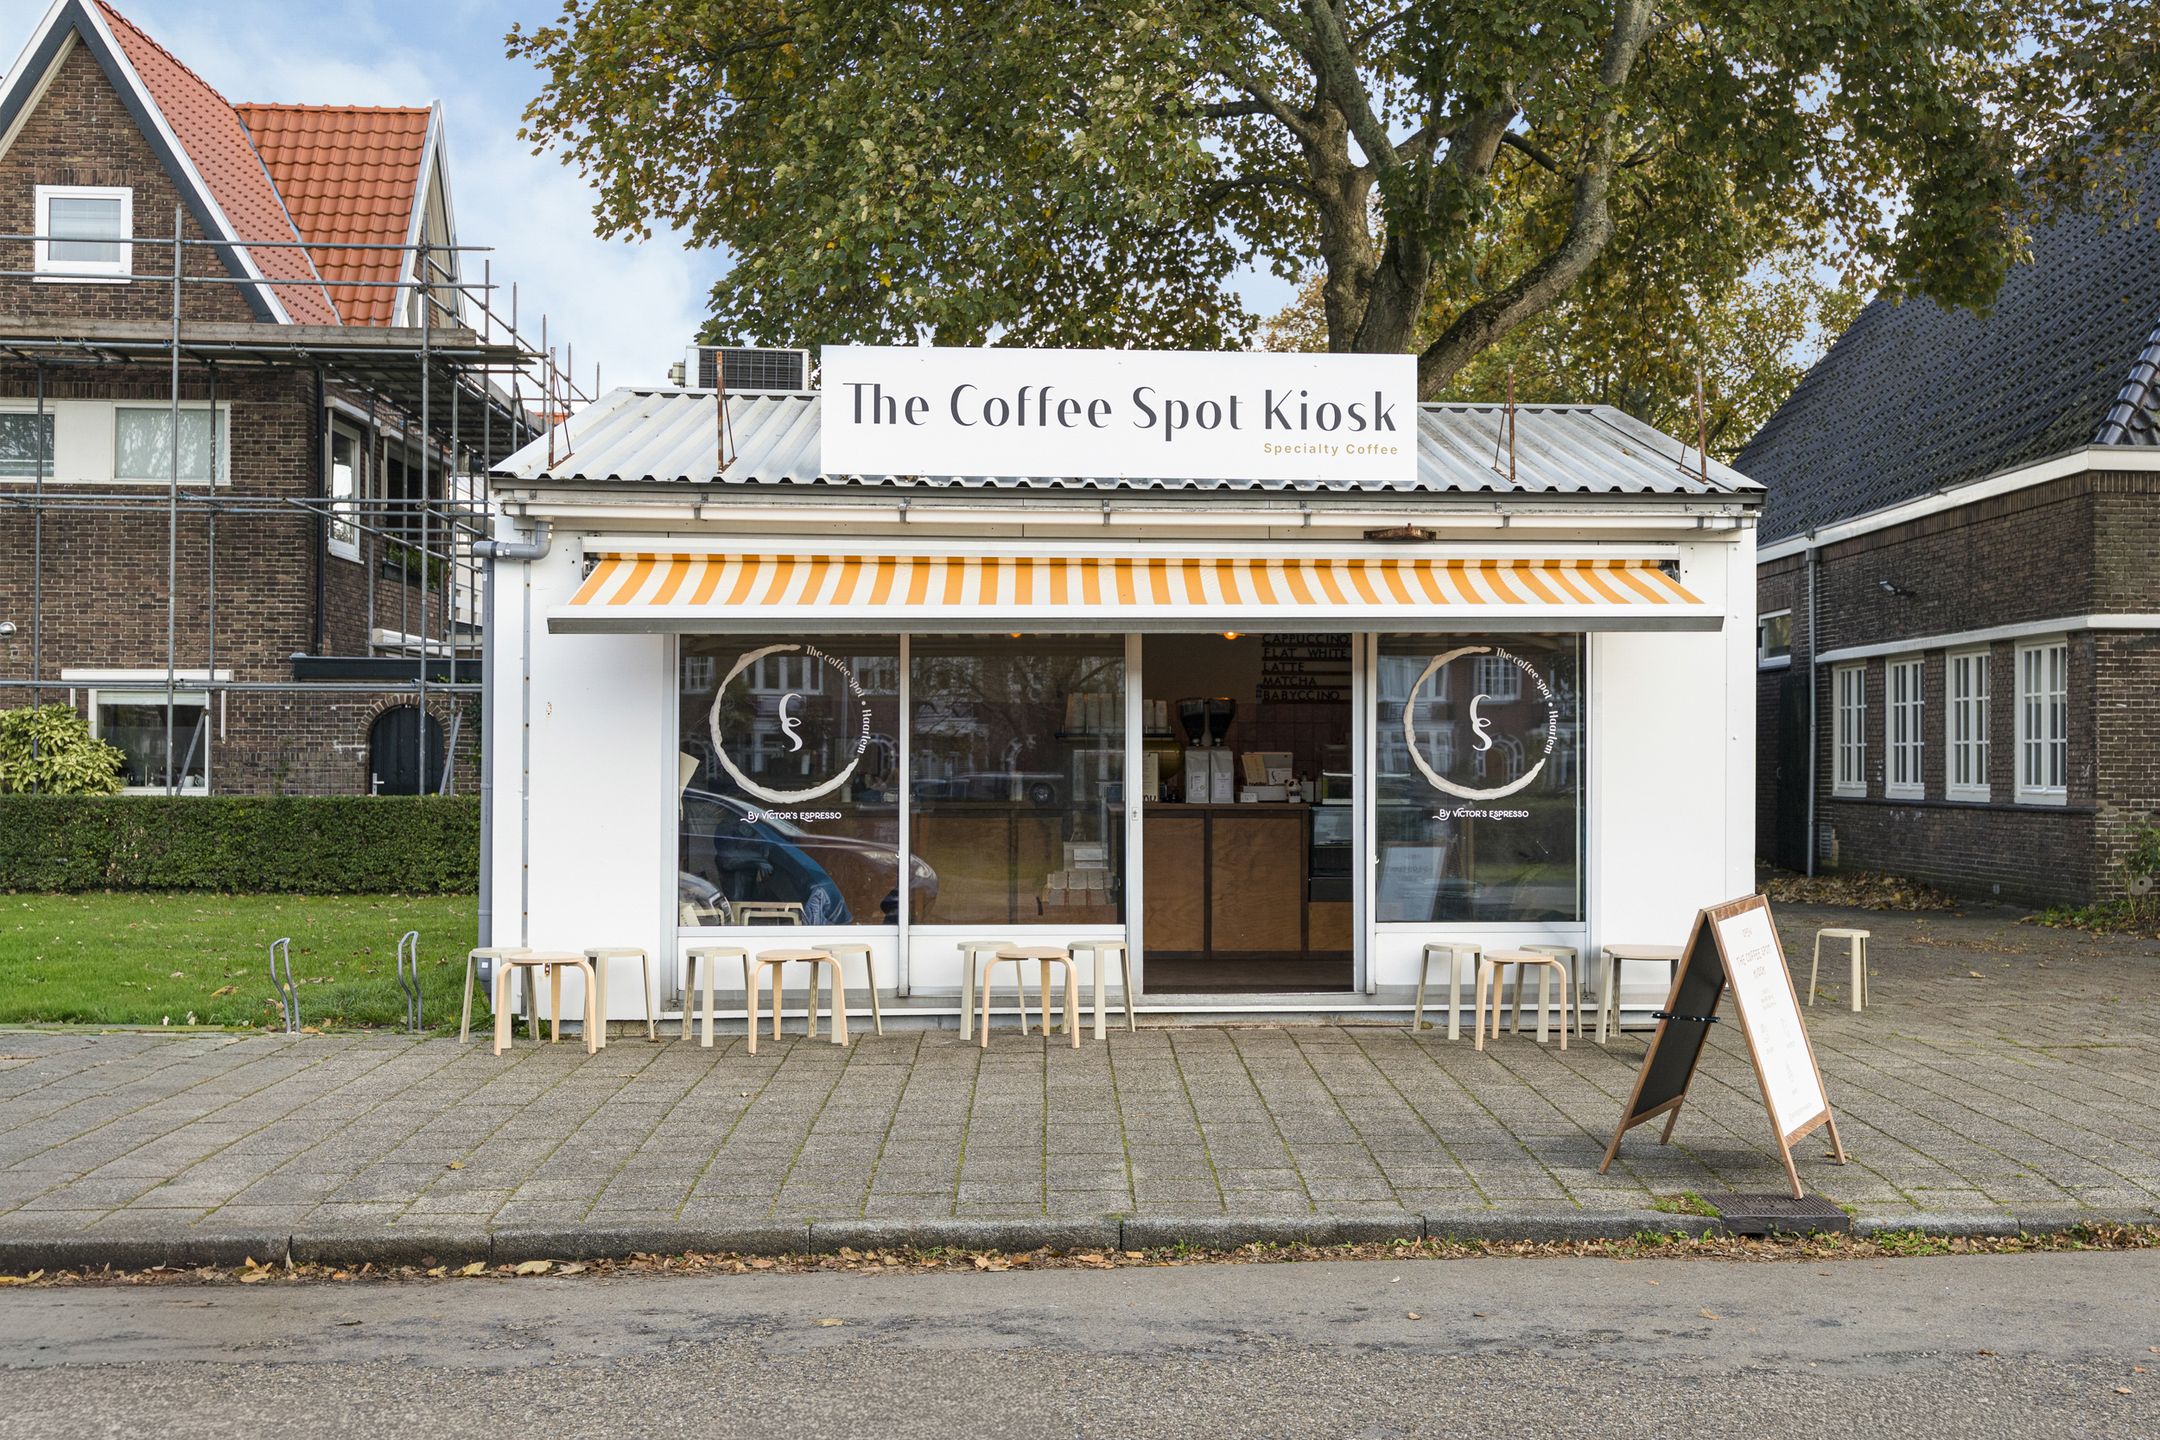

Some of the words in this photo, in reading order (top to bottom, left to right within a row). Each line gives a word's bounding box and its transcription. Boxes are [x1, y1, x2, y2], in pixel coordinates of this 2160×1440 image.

[843, 382, 930, 426] The
[950, 383, 1112, 429] Coffee
[1133, 386, 1243, 441] Spot
[1265, 389, 1397, 432] Kiosk
[1264, 443, 1339, 456] Specialty
[1346, 443, 1398, 455] Coffee
[1262, 634, 1349, 644] CAPPUCCINO
[1263, 647, 1297, 657] FLAT
[1307, 648, 1347, 658] WHITE
[1496, 647, 1512, 661] The
[1263, 662, 1305, 673] LATTE
[1512, 656, 1539, 680] coffee
[1263, 677, 1318, 686] MATCHA
[1263, 690, 1341, 701] BABYCCINO
[1536, 678, 1553, 700] spot
[805, 644, 823, 659] The
[824, 654, 851, 678] coffee
[848, 676, 865, 698] spot
[857, 708, 872, 754] Haarlem
[1544, 710, 1559, 754] Haarlem
[740, 811, 759, 823] By
[800, 811, 842, 823] ESPRESSO
[1432, 808, 1451, 821] By
[1489, 809, 1529, 821] ESPRESSO
